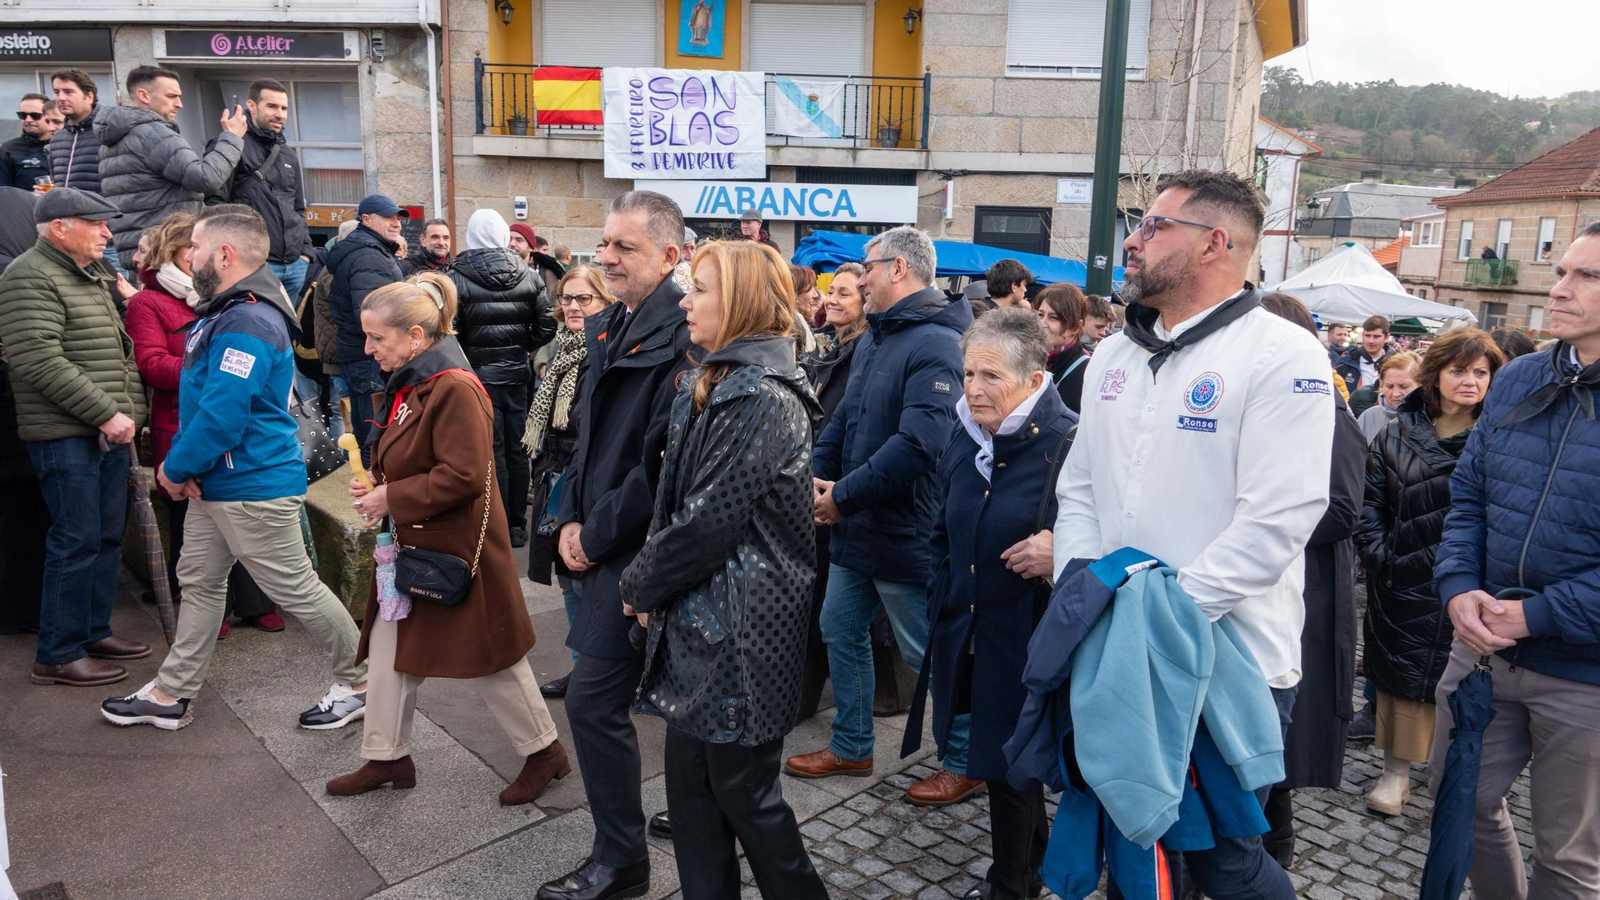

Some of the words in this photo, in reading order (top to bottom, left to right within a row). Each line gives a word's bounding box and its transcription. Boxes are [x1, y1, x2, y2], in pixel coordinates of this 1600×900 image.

[235, 35, 295, 51] Atelier
[648, 75, 738, 110] SAN
[629, 78, 645, 156] FEBREIRO
[648, 110, 740, 146] BLAS
[631, 162, 645, 173] 3
[652, 151, 739, 171] BEMBRIVE
[710, 186, 857, 217] ABANCA
[1104, 368, 1131, 384] SAN
